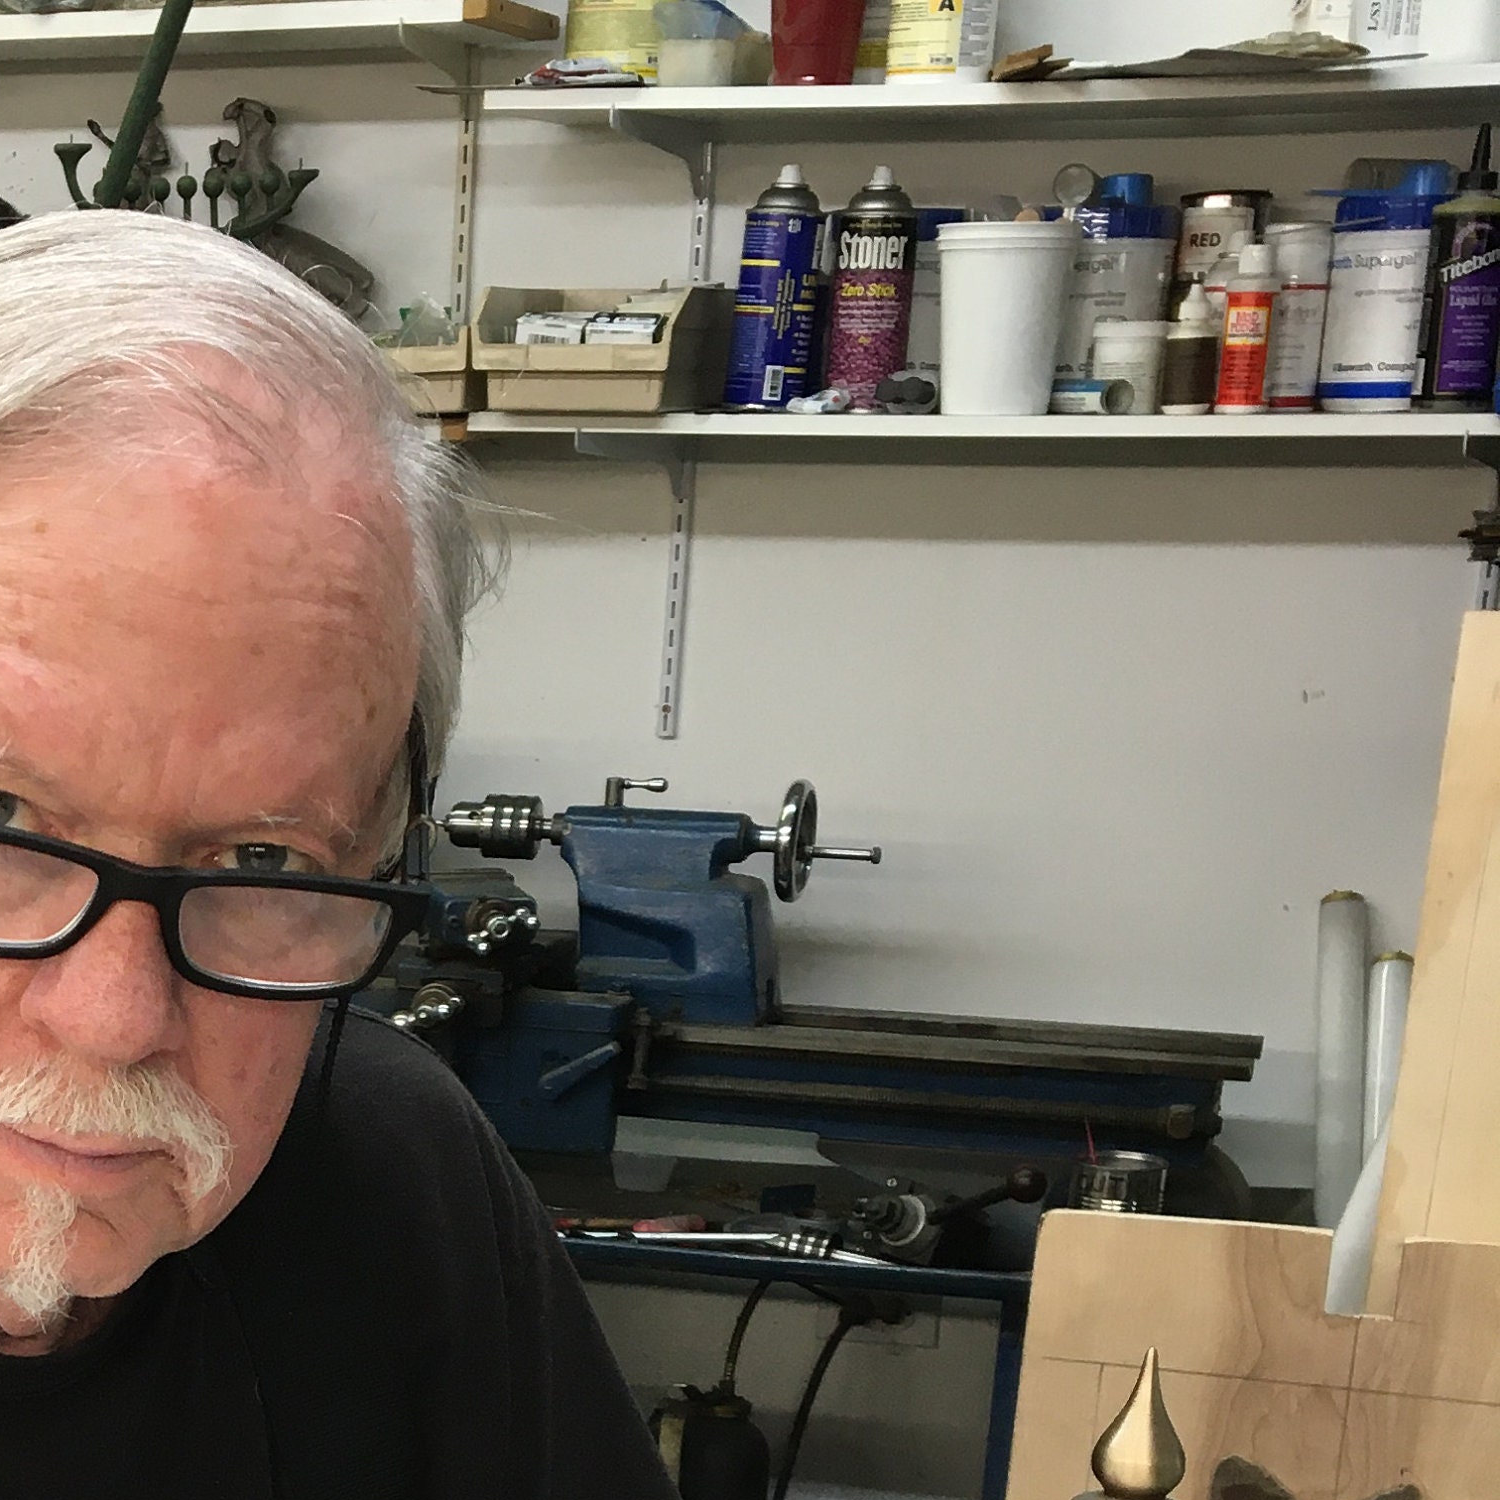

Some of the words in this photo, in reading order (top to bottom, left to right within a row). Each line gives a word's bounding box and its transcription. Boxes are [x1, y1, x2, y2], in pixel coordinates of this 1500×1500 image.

[1189, 233, 1221, 247] RED
[839, 230, 908, 270] Stoner
[841, 283, 866, 297] Zero
